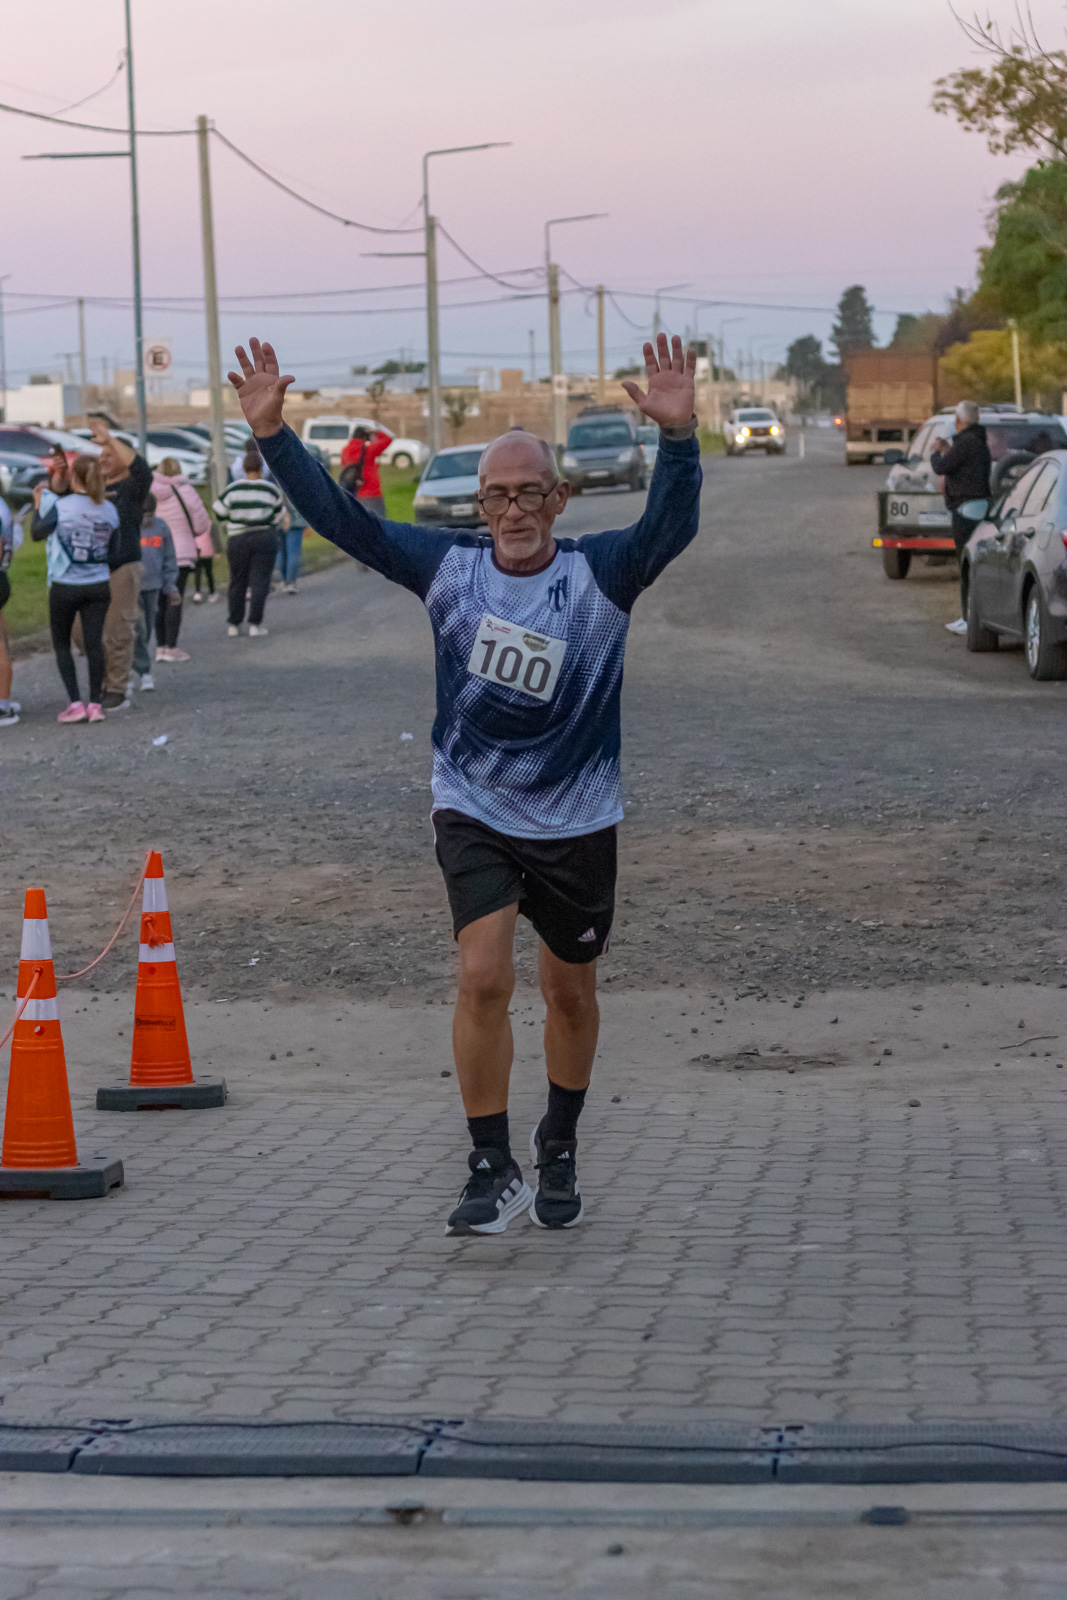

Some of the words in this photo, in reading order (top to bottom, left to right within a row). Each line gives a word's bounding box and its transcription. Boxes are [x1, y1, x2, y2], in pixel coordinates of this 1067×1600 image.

[153, 351, 164, 366] E
[890, 501, 909, 516] 80
[480, 639, 552, 693] 100
